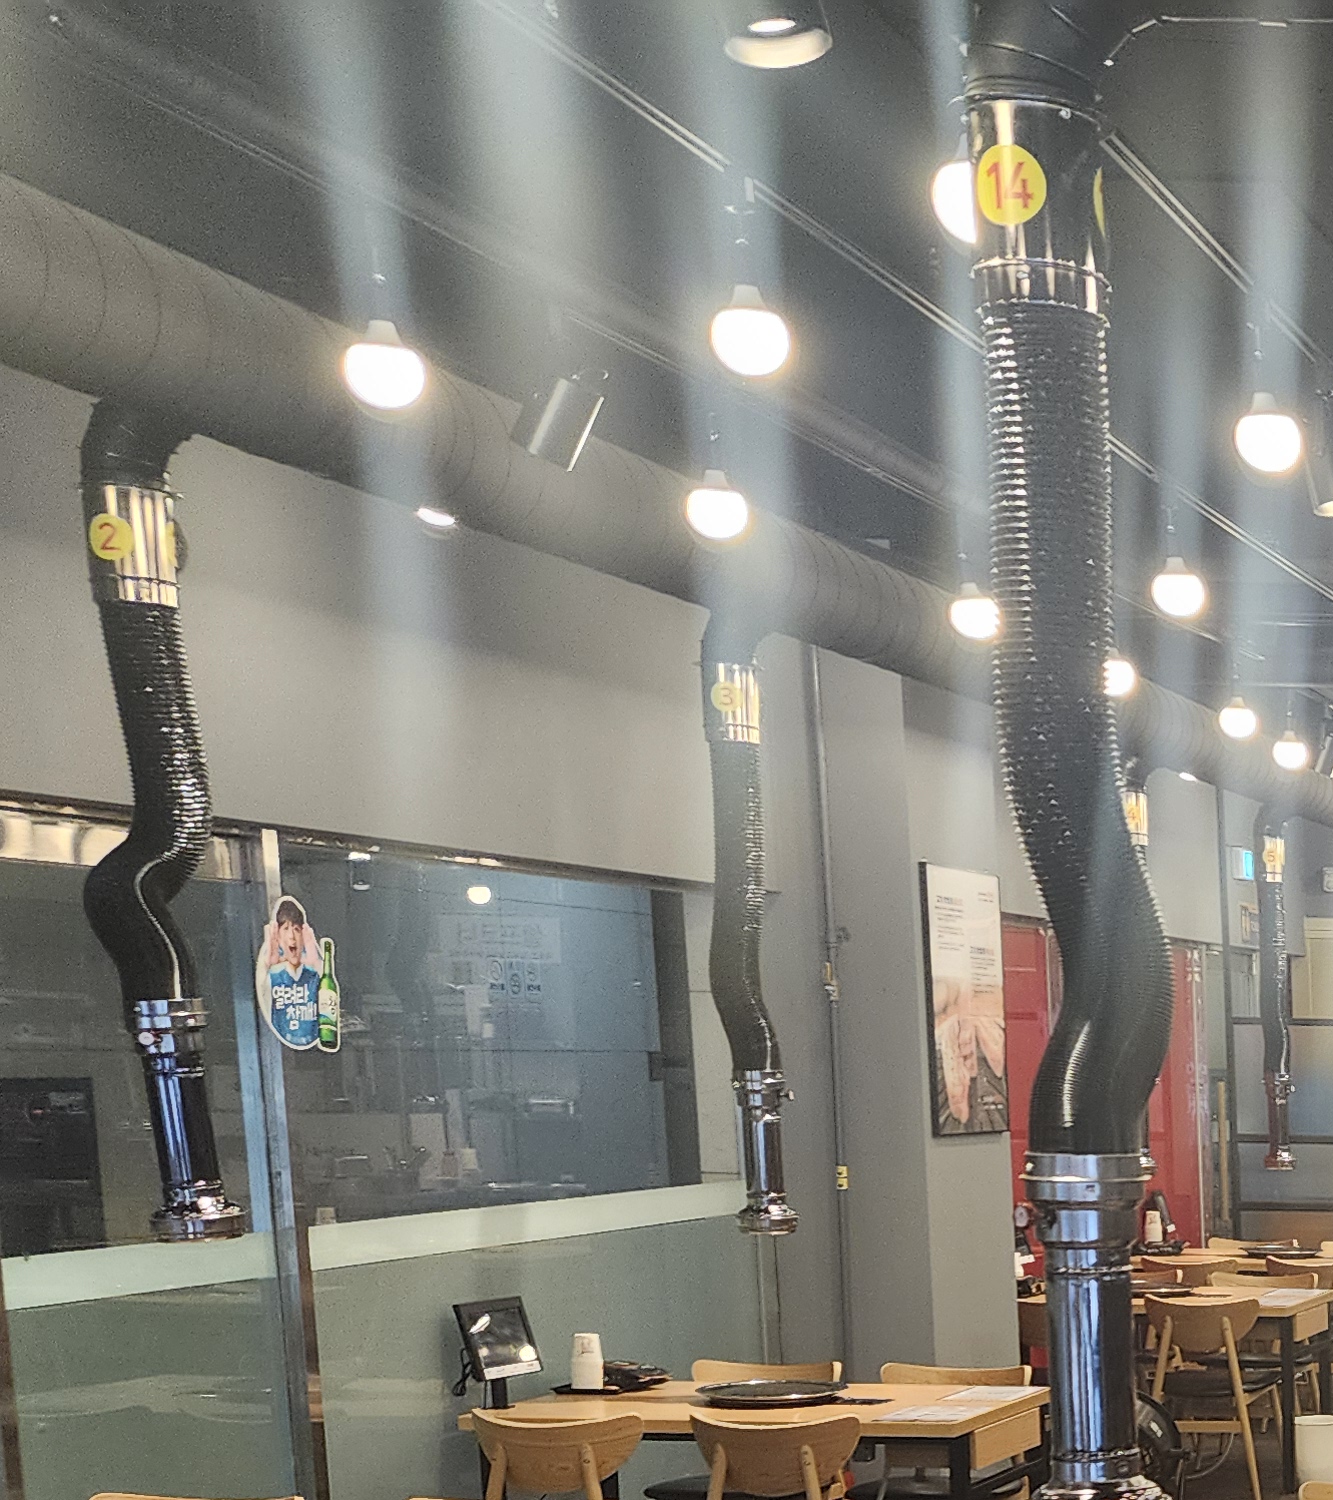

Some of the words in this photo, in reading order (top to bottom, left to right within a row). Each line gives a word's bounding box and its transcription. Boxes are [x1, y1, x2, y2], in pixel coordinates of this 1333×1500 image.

[985, 161, 1034, 210] 14
[98, 522, 121, 551] 2
[719, 687, 733, 706] 3
[1267, 850, 1276, 862] 5
[272, 983, 310, 1010] 열려라
